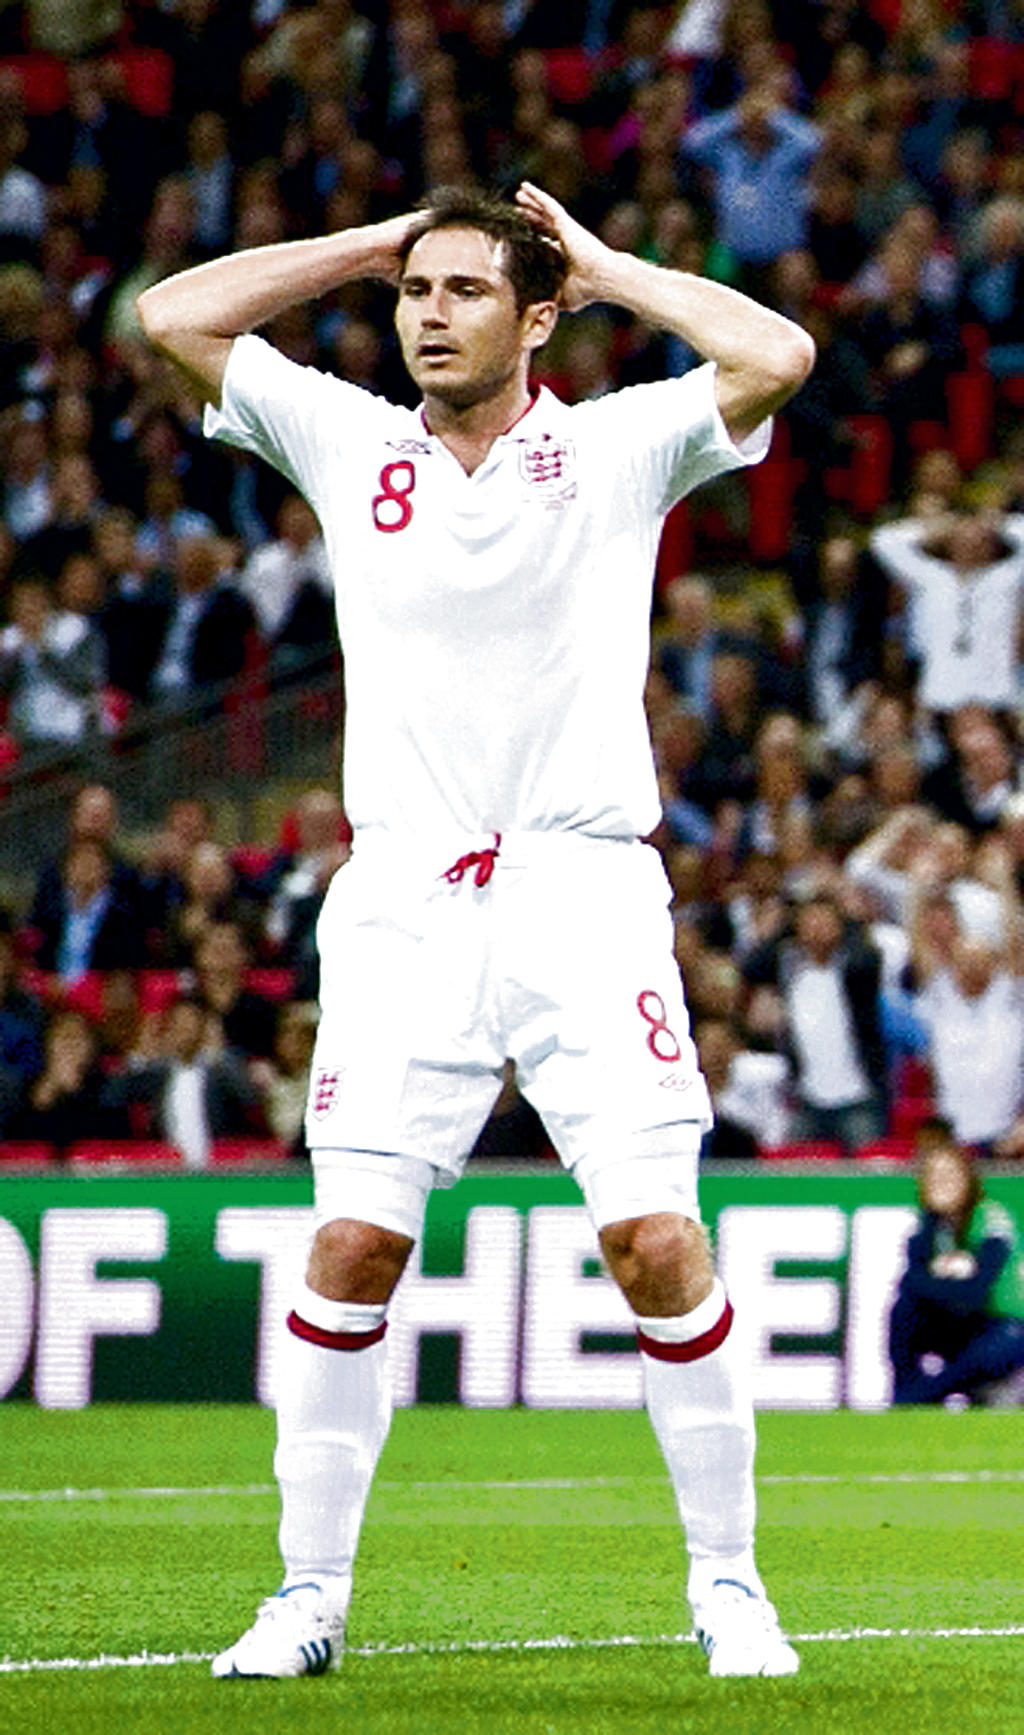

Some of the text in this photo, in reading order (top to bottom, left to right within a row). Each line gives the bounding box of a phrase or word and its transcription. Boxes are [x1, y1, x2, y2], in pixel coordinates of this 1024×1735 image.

[372, 460, 416, 533] 8
[636, 989, 682, 1064] 8
[0, 1207, 168, 1409] F
[214, 1206, 646, 1409] THE
